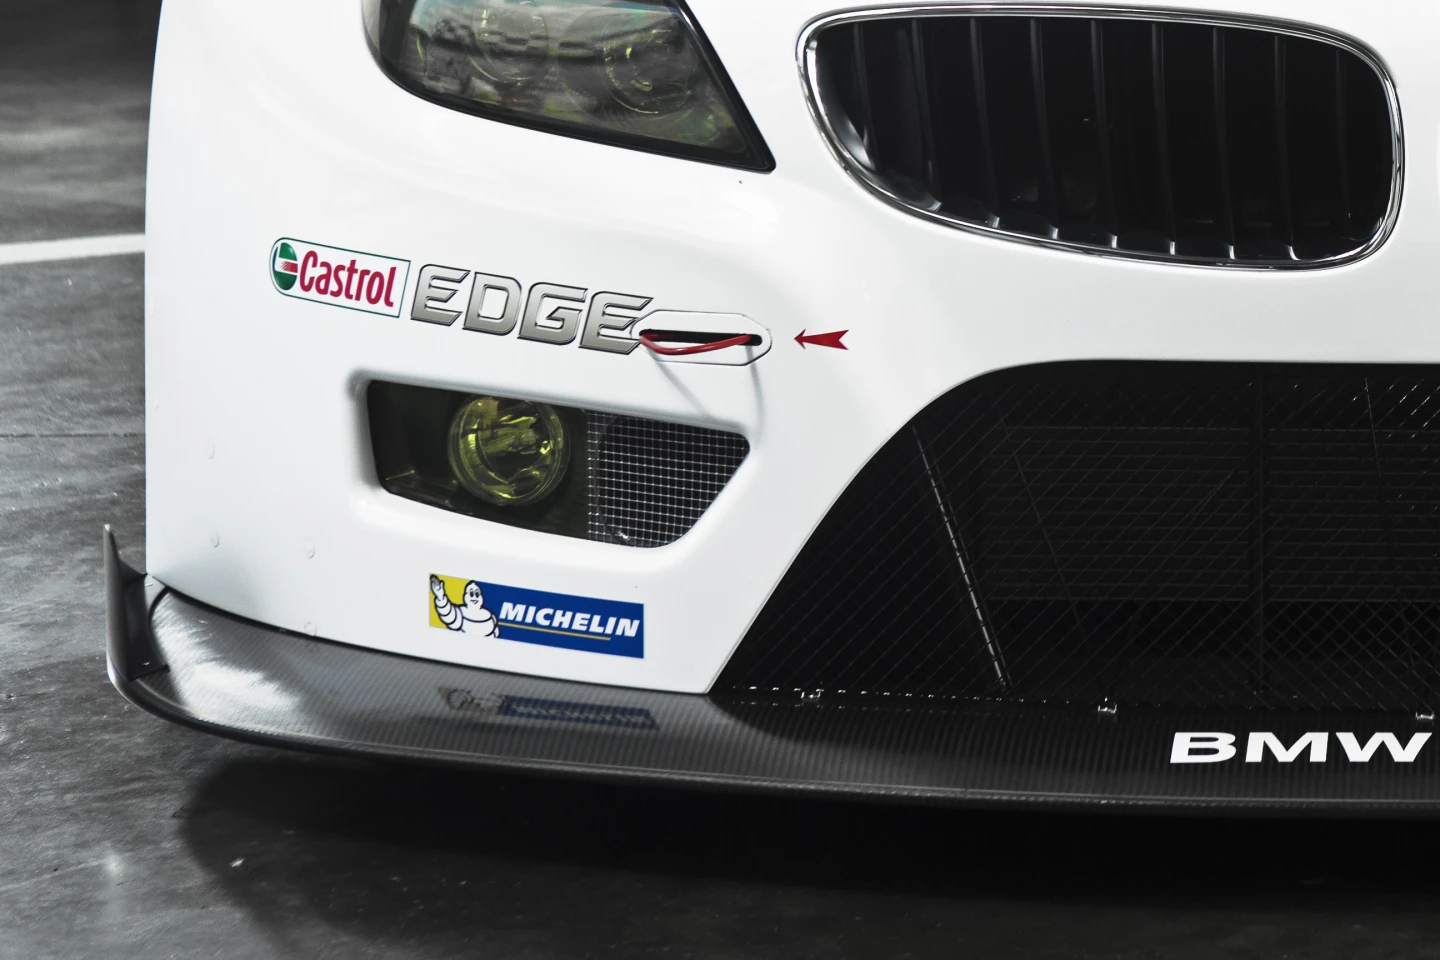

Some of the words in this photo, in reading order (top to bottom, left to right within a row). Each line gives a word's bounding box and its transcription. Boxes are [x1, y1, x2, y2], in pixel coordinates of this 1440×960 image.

[299, 250, 397, 308] Castrol
[410, 263, 655, 356] EDGE
[499, 601, 641, 638] MICHELIN
[1169, 731, 1433, 764] BMW
